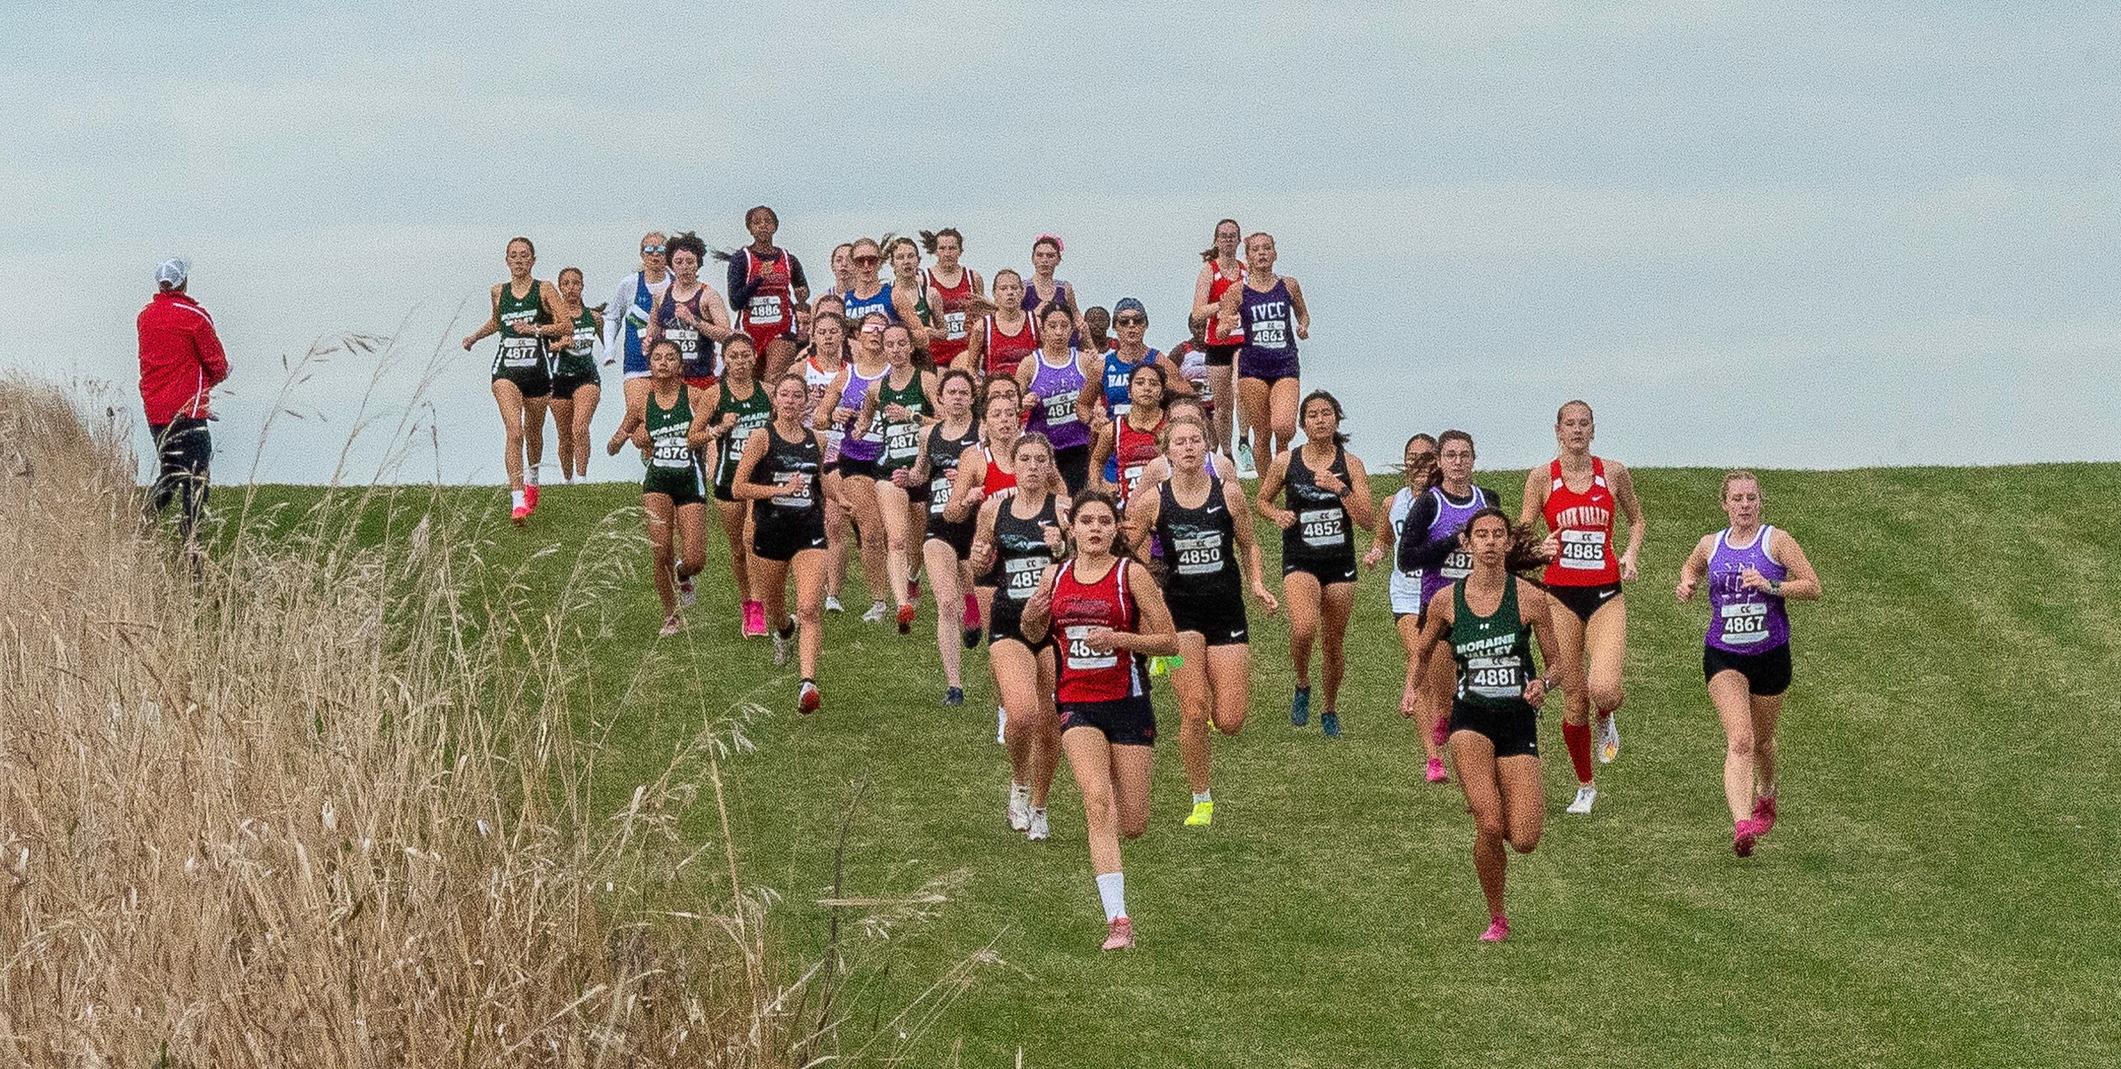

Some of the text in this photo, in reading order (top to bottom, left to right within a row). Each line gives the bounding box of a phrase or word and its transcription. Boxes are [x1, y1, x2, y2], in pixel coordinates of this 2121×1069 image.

[751, 305, 780, 317] 4886
[1251, 302, 1285, 321] IVCC
[1253, 330, 1285, 343] 4863
[505, 347, 536, 360] 4877
[654, 447, 689, 459] 4876
[1303, 520, 1343, 537] 4852
[1178, 547, 1221, 564] 4850
[1563, 542, 1603, 560] 4885
[1725, 616, 1765, 633] 4867
[1456, 633, 1516, 655] MORAINE
[1474, 668, 1516, 686] 4881
